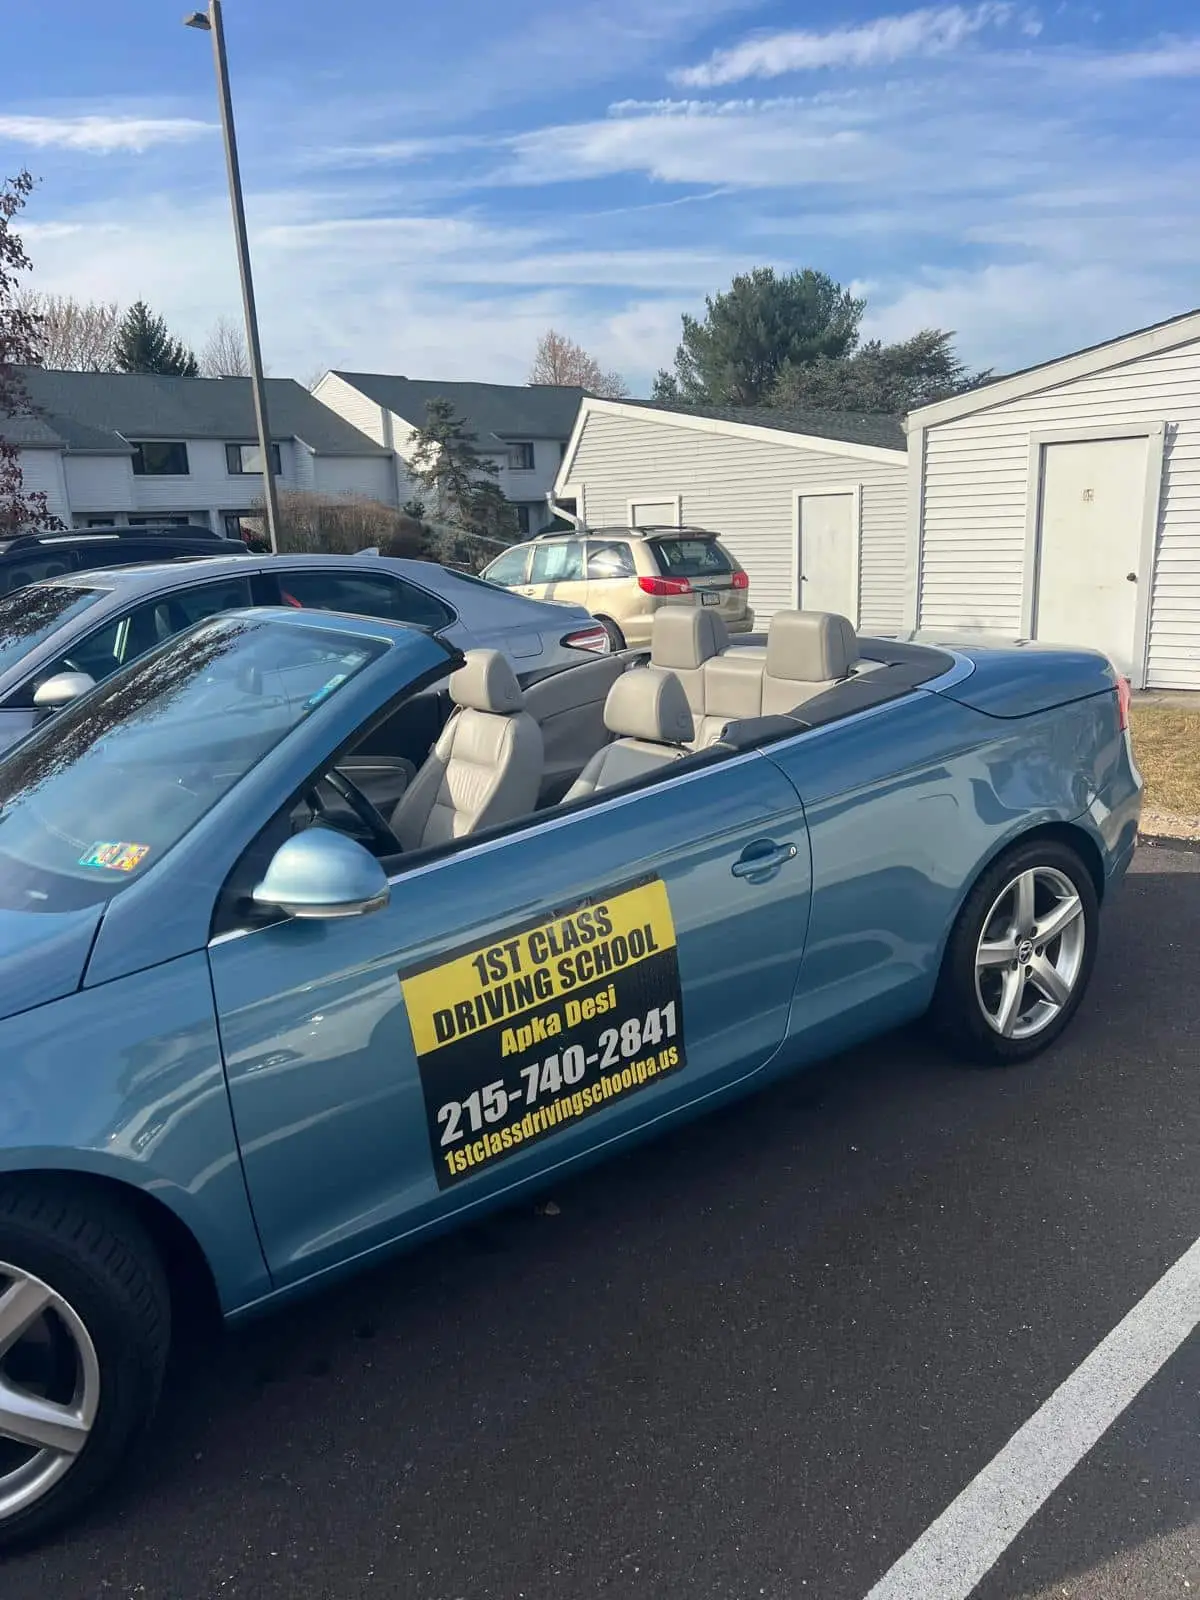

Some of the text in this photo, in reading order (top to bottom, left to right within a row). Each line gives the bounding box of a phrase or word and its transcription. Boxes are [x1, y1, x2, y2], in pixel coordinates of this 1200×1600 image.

[432, 924, 659, 1044] DRIVING SCHOOL
[472, 905, 612, 987] 1ST CLASS
[437, 1000, 676, 1146] 215-740-2841
[502, 984, 617, 1057] Apka Desi
[444, 1046, 679, 1175] 1stclassdrivingschoolpa.us
